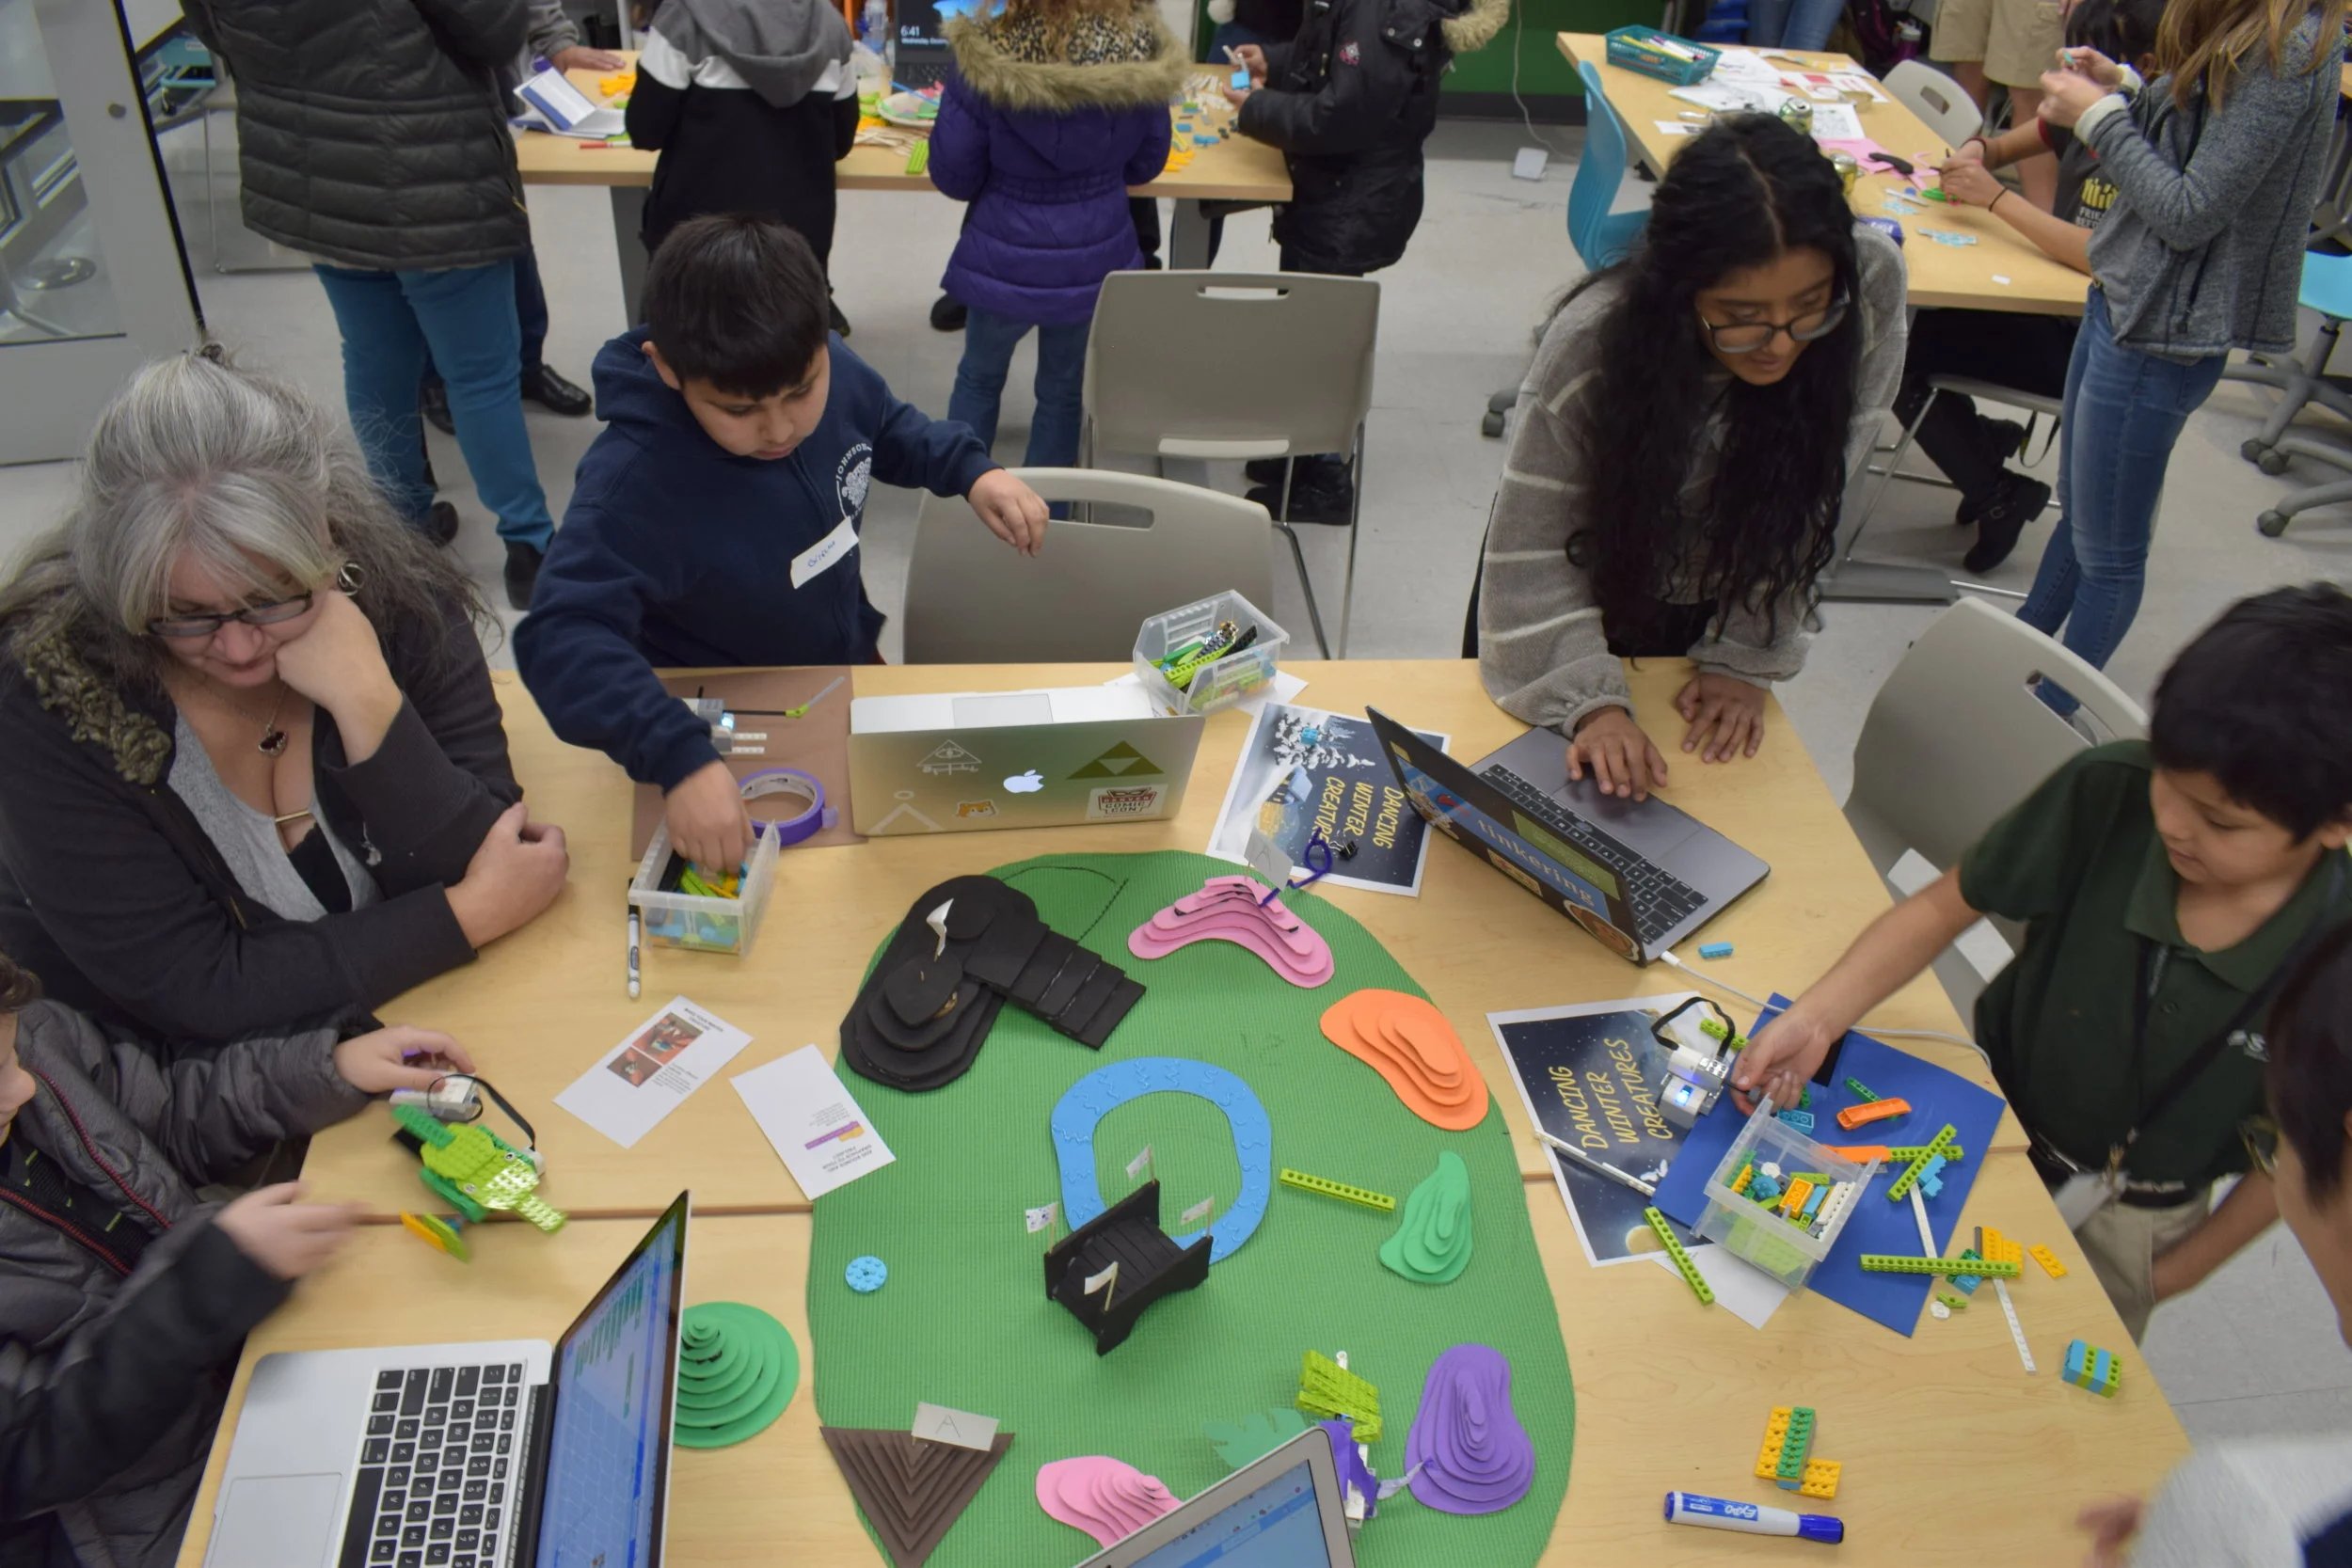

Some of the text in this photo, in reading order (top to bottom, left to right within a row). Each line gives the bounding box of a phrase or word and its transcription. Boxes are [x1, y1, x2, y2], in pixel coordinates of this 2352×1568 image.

[2079, 206, 2105, 220] FRIE
[835, 443, 867, 482] JOHNSON
[1309, 776, 1346, 846] CREATURE
[1343, 782, 1374, 836] WINTER
[1373, 786, 1405, 848] DANCING
[1477, 819, 1595, 907] tinkering
[1549, 1066, 1609, 1148] DANCING
[1586, 1071, 1641, 1143] WINTER
[1603, 1037, 1673, 1139] CREATURES
[935, 1414, 961, 1438] A
